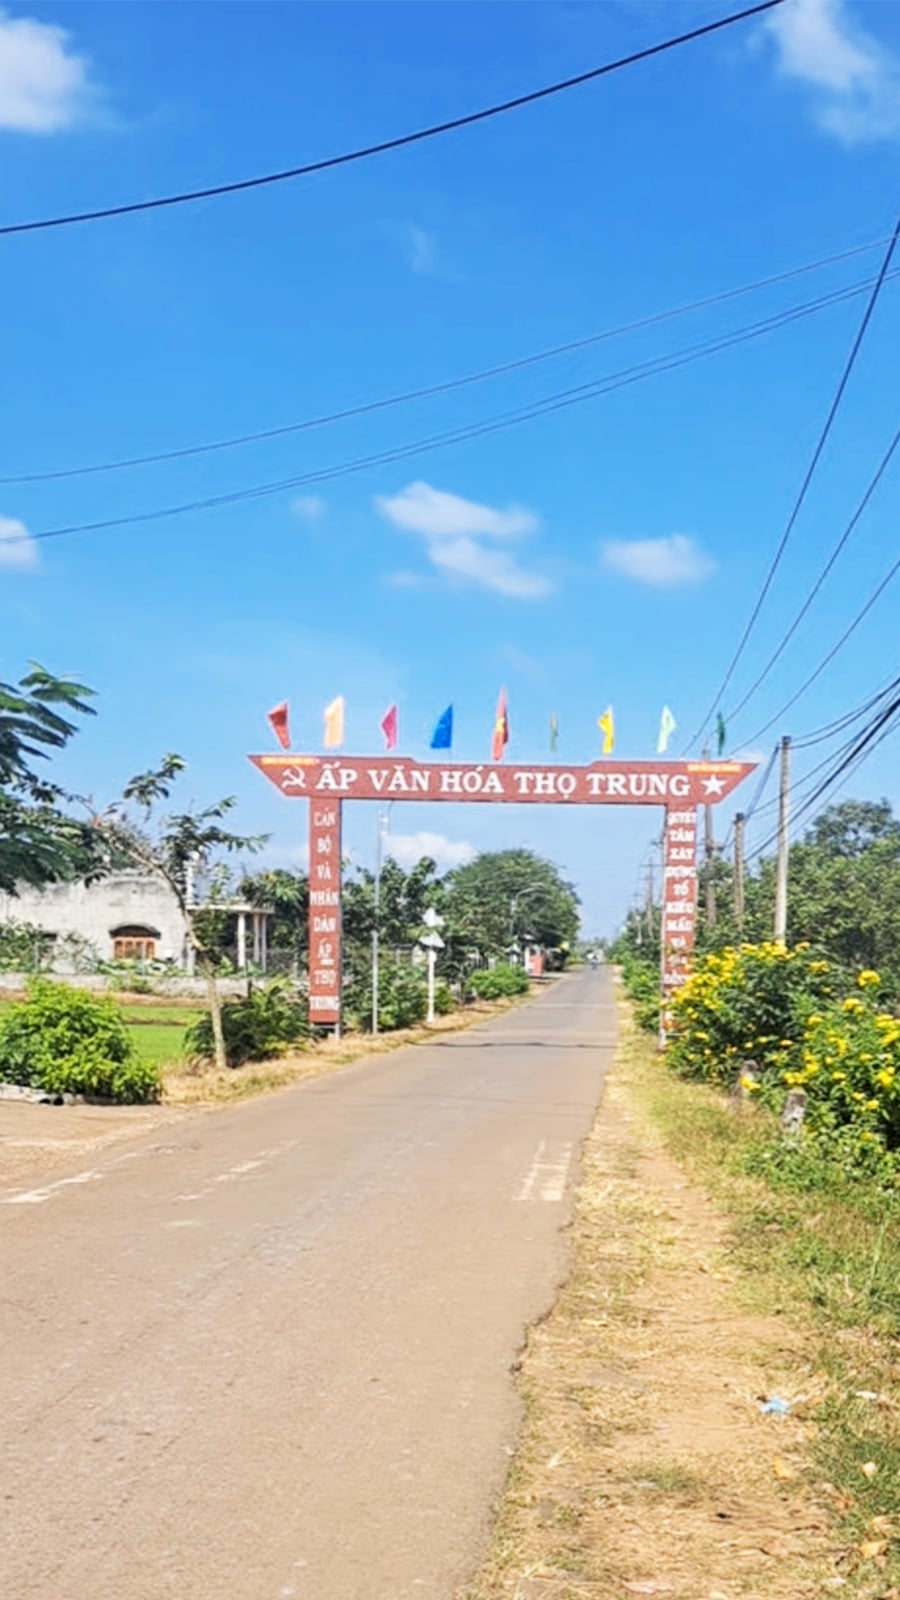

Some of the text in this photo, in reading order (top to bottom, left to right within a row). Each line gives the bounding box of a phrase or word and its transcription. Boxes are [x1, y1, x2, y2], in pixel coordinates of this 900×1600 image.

[315, 760, 692, 799] ẤP VĂN HÓA THỌ TRUNG
[316, 834, 332, 855] BỘ
[316, 861, 332, 880] VÀ
